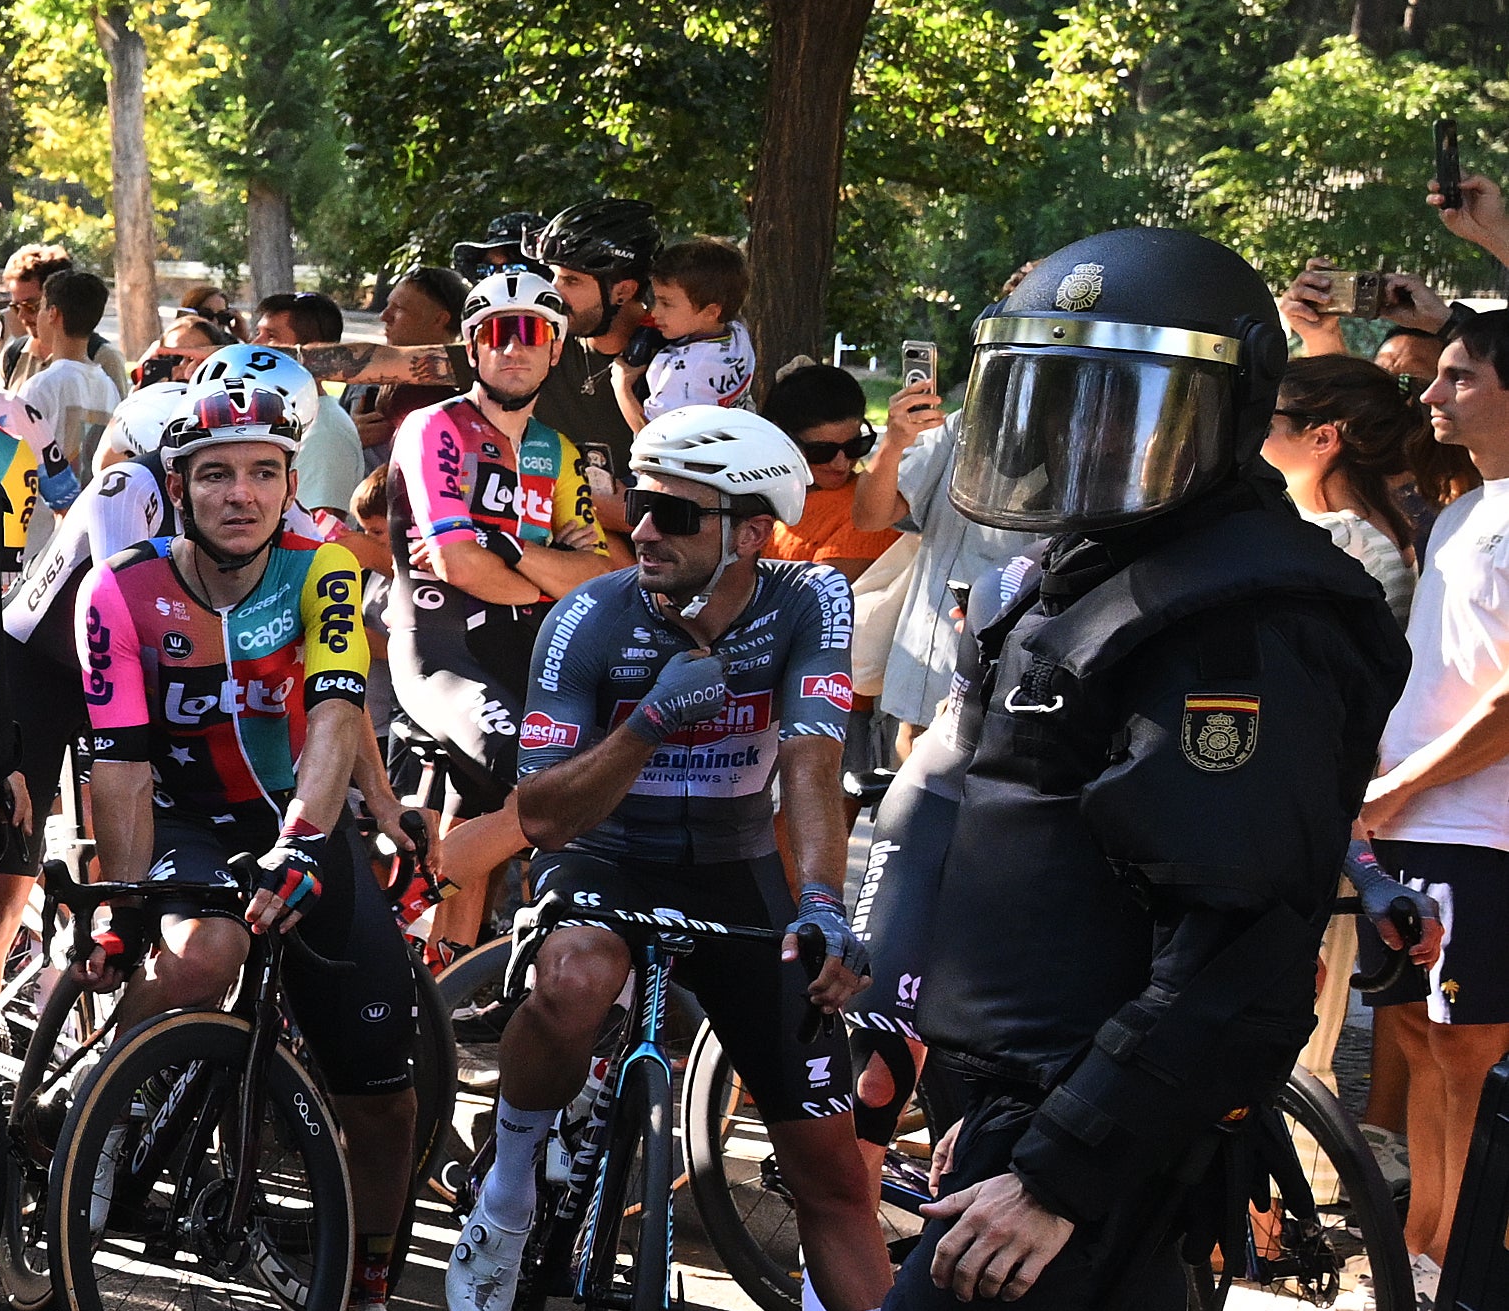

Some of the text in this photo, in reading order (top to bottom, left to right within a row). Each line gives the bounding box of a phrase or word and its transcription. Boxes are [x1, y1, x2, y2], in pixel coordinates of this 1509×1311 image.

[522, 454, 554, 472] caps
[726, 464, 792, 484] CANYON
[27, 550, 66, 614] Q36.5
[236, 583, 292, 619] ORBEA
[236, 608, 295, 651] caps
[536, 589, 598, 693] deceuninck
[613, 667, 646, 677] ABUS
[665, 683, 727, 714] WHOOP
